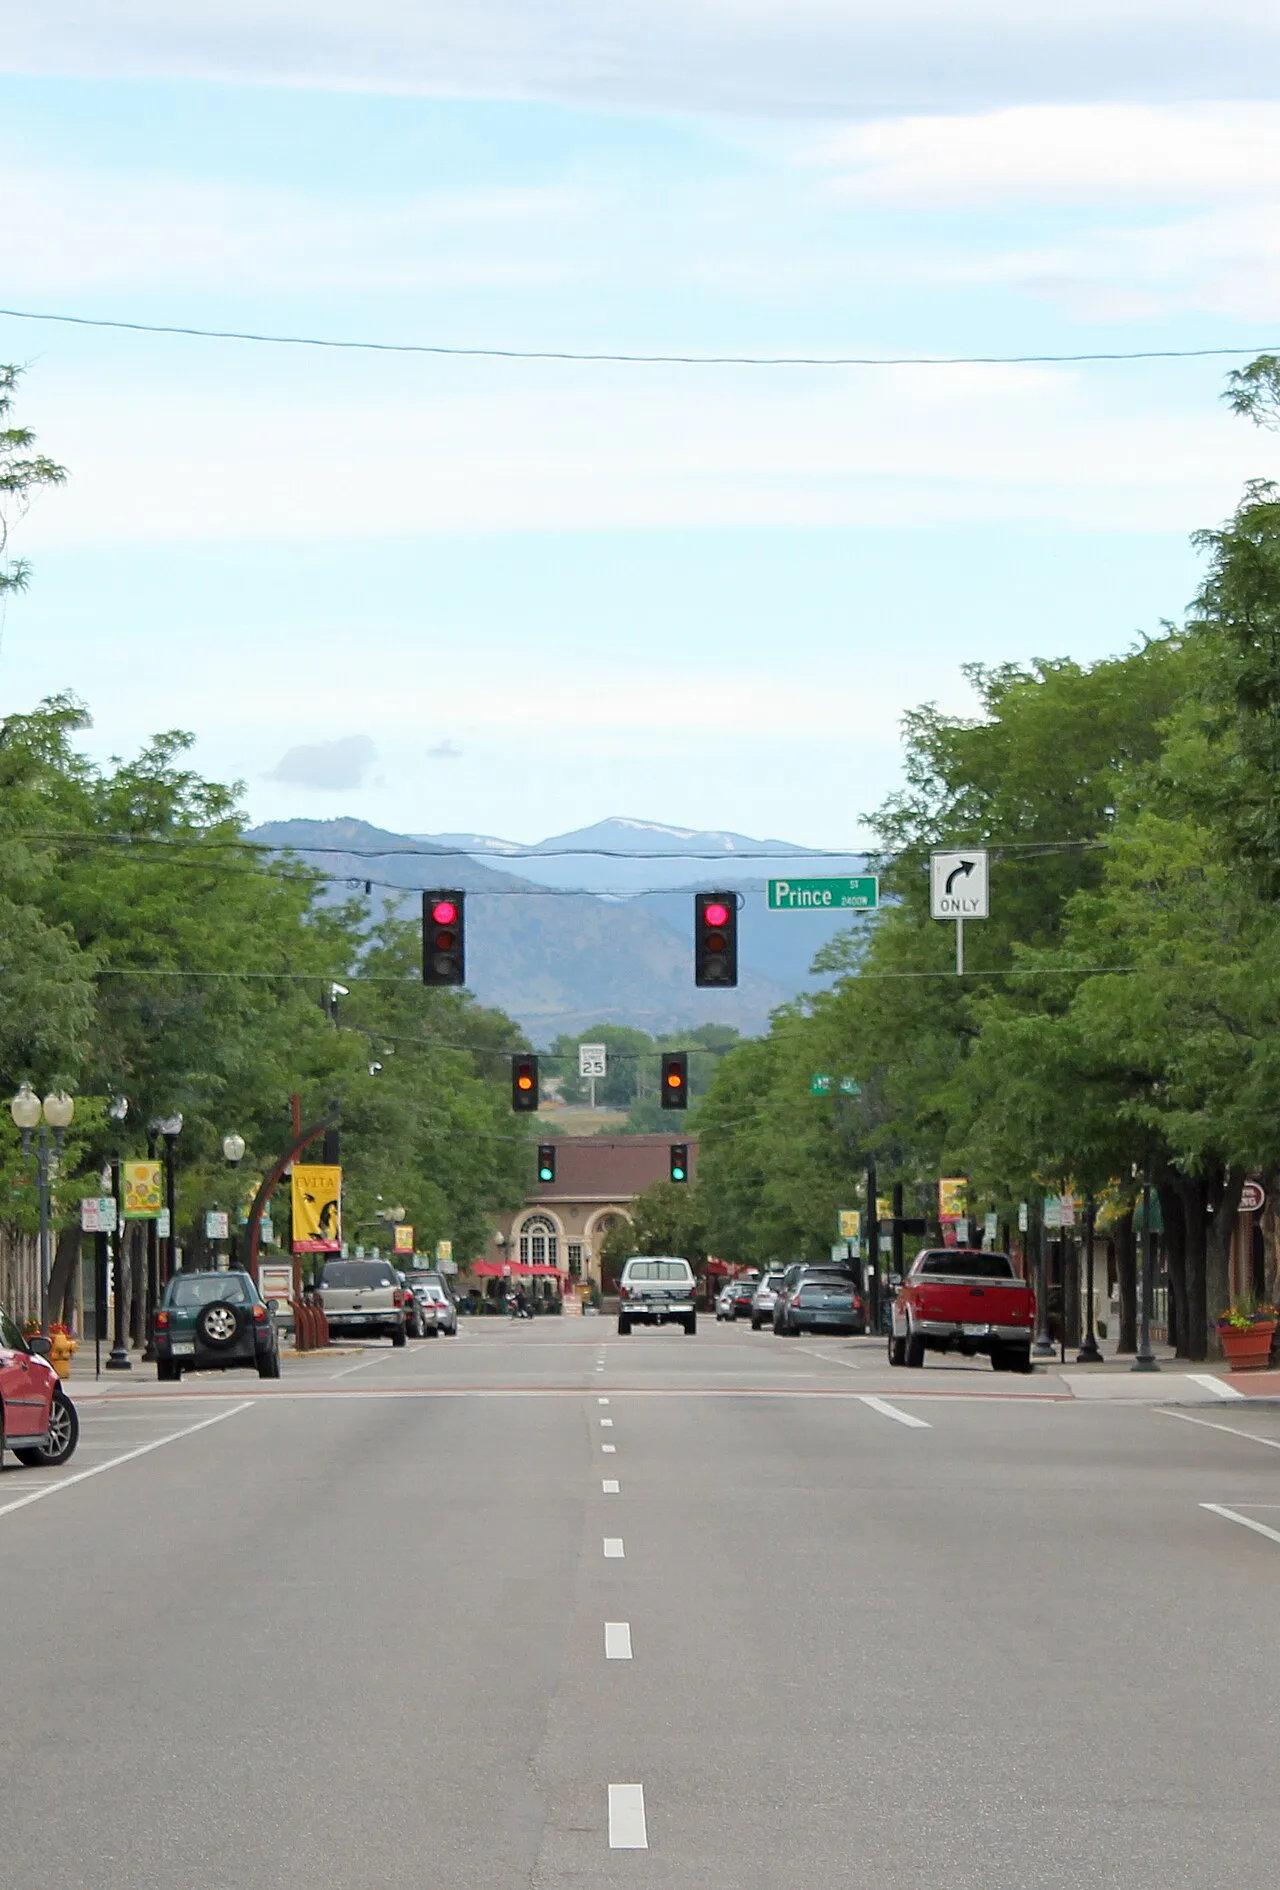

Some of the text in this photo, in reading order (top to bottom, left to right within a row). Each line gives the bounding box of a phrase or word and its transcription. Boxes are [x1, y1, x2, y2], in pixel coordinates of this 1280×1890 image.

[775, 881, 832, 906] Prince
[841, 896, 868, 906] 2400W
[940, 899, 980, 912] ONLY
[583, 1061, 604, 1073] 25
[296, 1176, 335, 1188] EVITA
